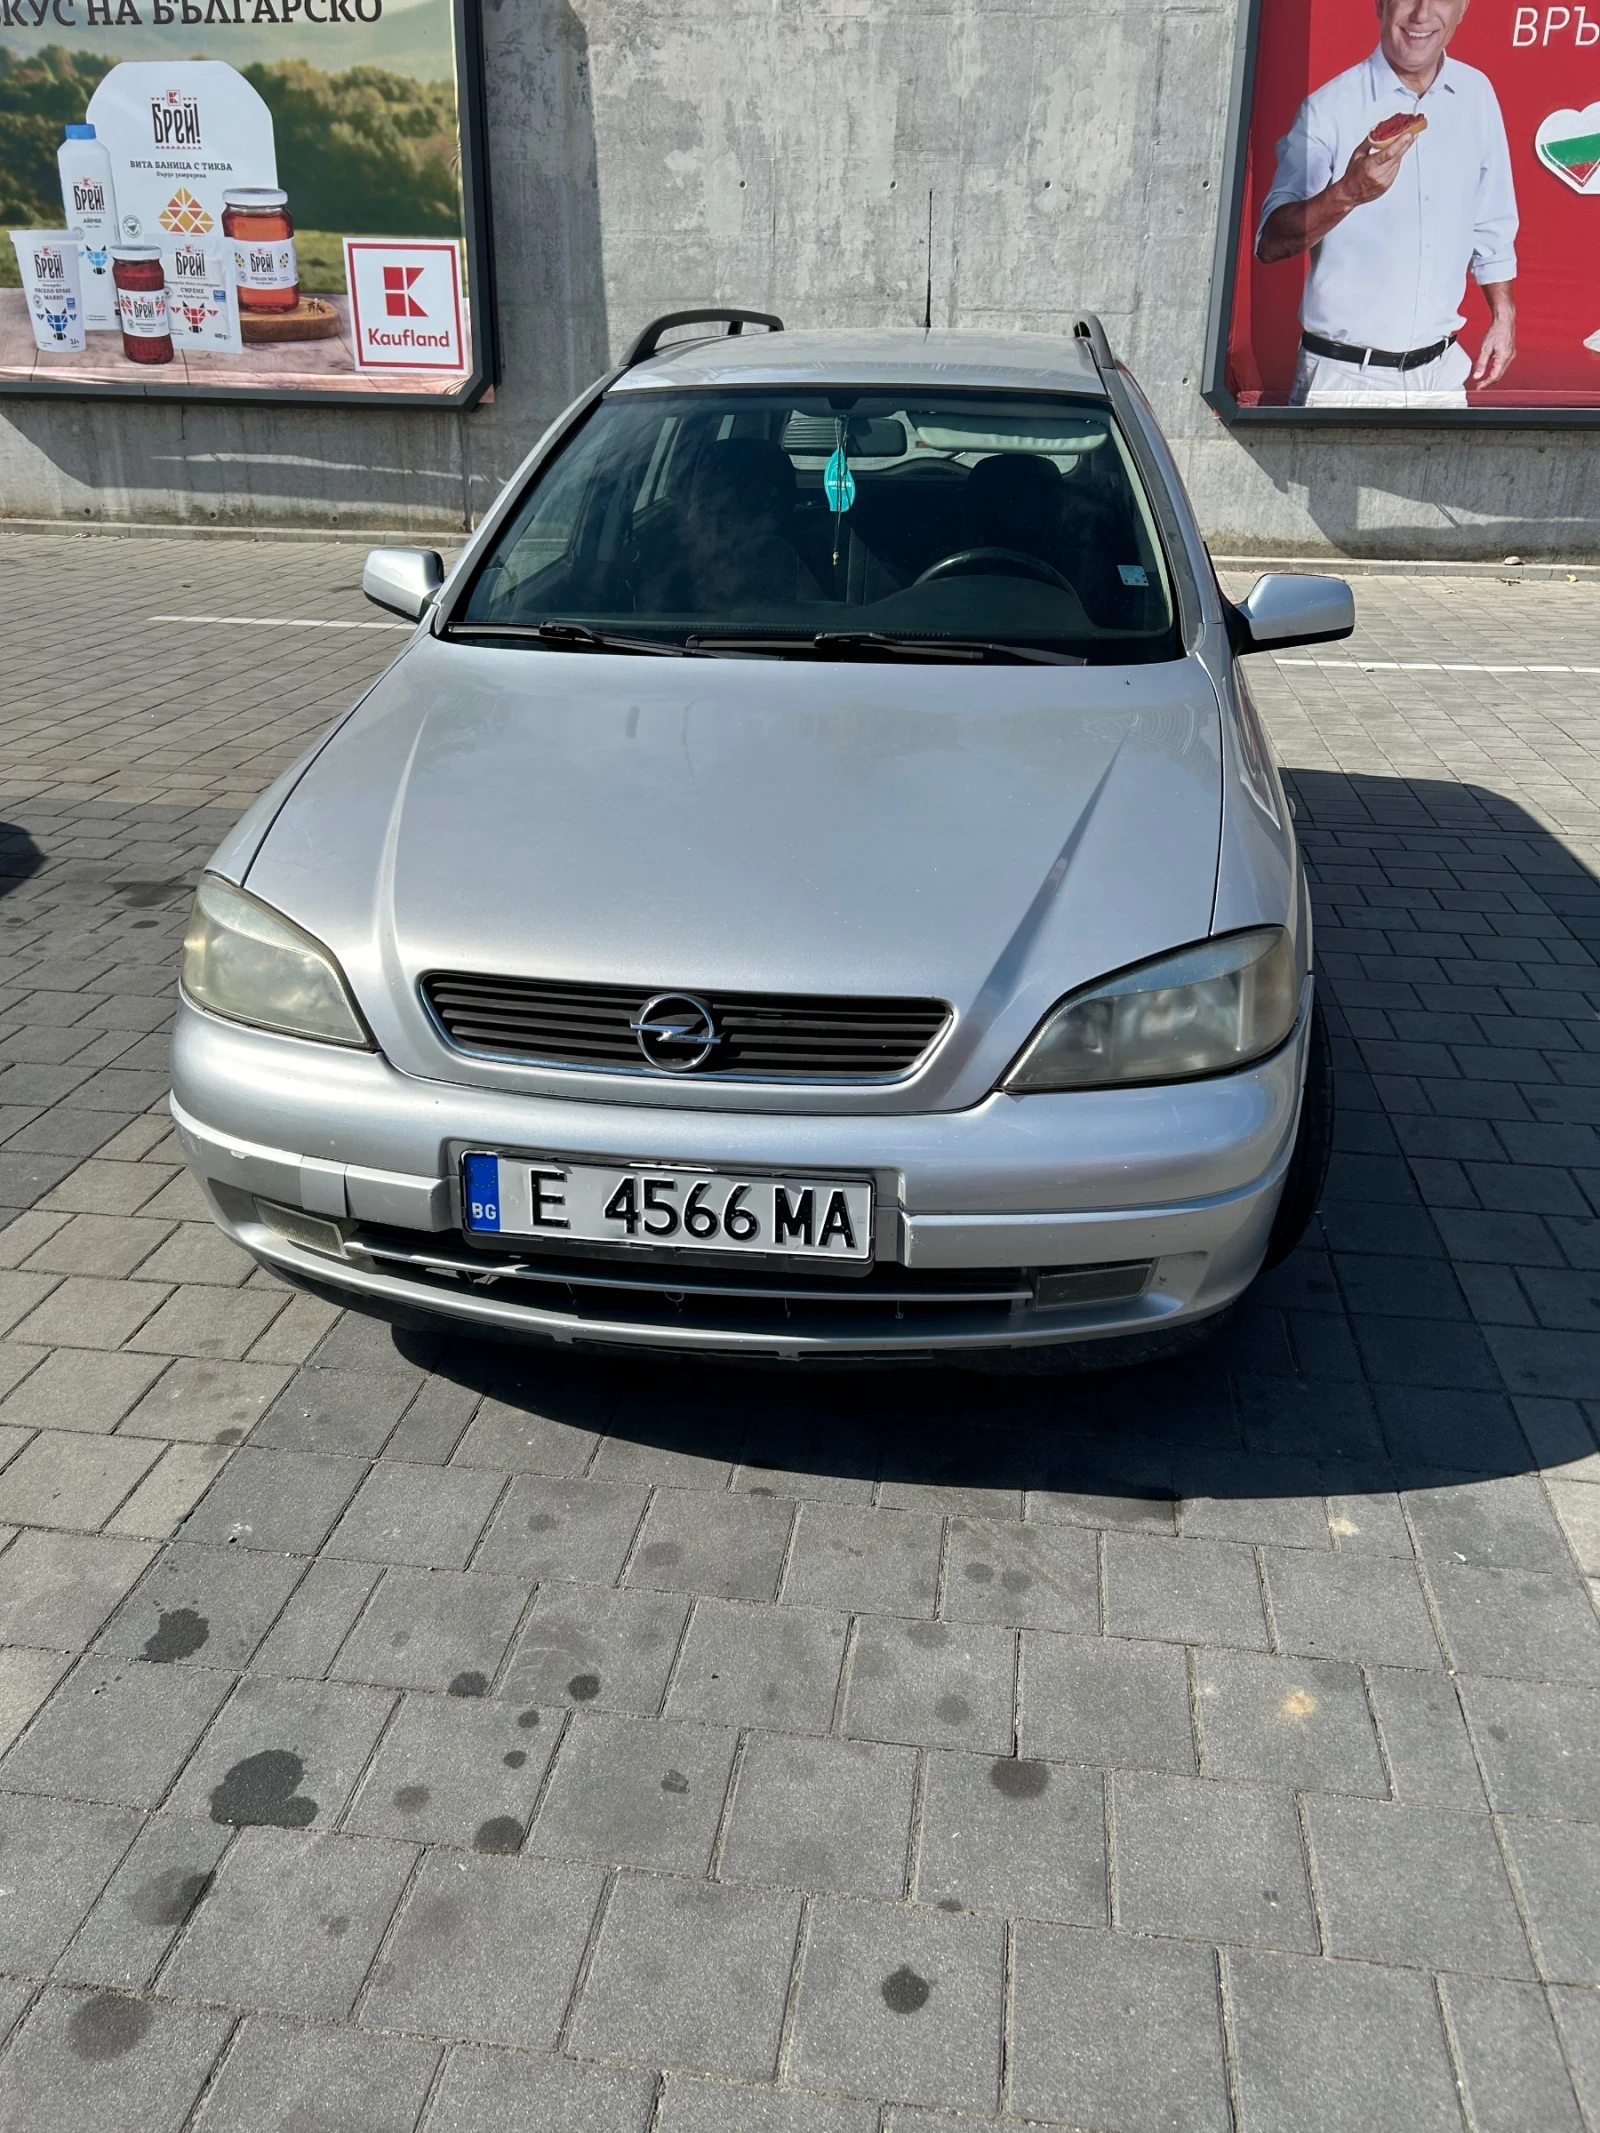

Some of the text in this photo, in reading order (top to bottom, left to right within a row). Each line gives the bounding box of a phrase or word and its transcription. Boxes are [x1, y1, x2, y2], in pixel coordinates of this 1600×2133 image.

[0, 0, 383, 26] КУС НА БЪЛГАРСКО
[1512, 6, 1600, 47] ВРЪ
[130, 160, 233, 171] ВИТА БАНИЦА С ТИКВА
[368, 327, 450, 348] Kaufland
[471, 1202, 497, 1220] BG
[530, 1170, 858, 1249] E 4566 MA
